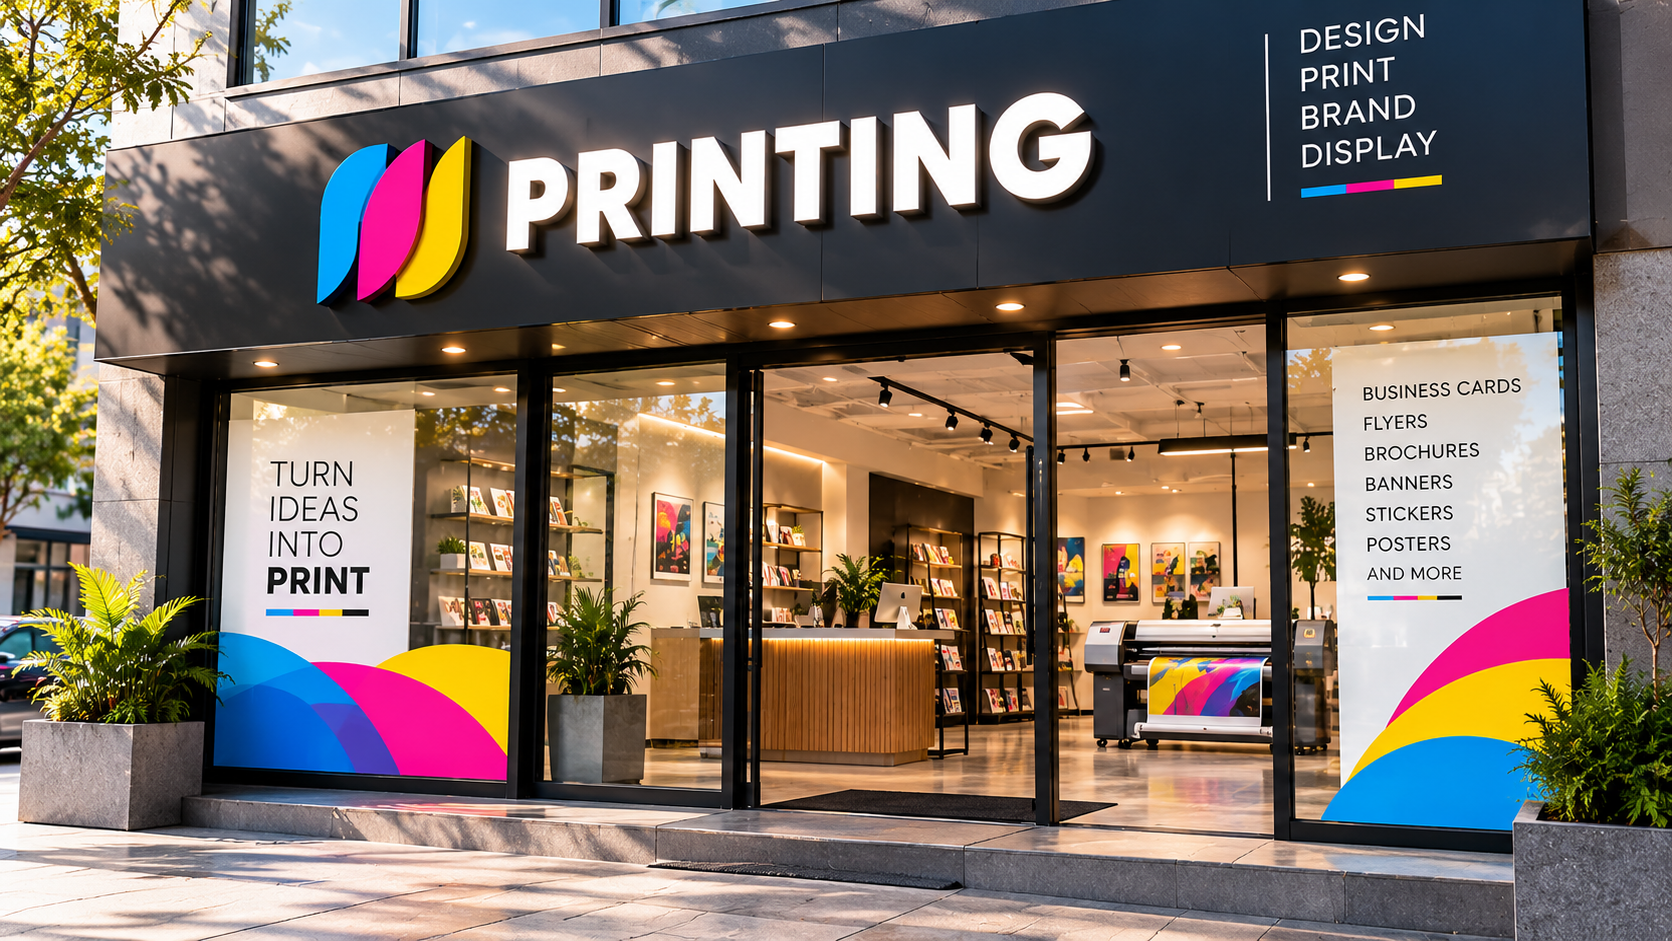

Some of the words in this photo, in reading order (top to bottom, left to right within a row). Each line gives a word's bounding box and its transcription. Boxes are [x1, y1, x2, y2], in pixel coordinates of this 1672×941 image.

[1300, 13, 1425, 54] DESIGN
[1300, 56, 1396, 92] PRINT
[1301, 94, 1416, 131] BRAND
[1301, 129, 1438, 169] DISPLAY
[505, 92, 1094, 253] PRINTING
[1363, 381, 1451, 401] BUSINESS
[1456, 377, 1522, 396] CARDS
[1363, 413, 1428, 431] FLYERS
[1364, 442, 1480, 462] BROCHURES
[270, 460, 353, 487] TURN
[1365, 474, 1453, 492] BANNERS
[270, 496, 359, 522] IDEAS
[1365, 505, 1454, 522] STICKERS
[269, 530, 343, 558] INTO
[1366, 535, 1451, 553] POSTERS
[266, 566, 370, 595] PRINT
[1366, 567, 1405, 581] AND
[1411, 565, 1463, 581] MORE
